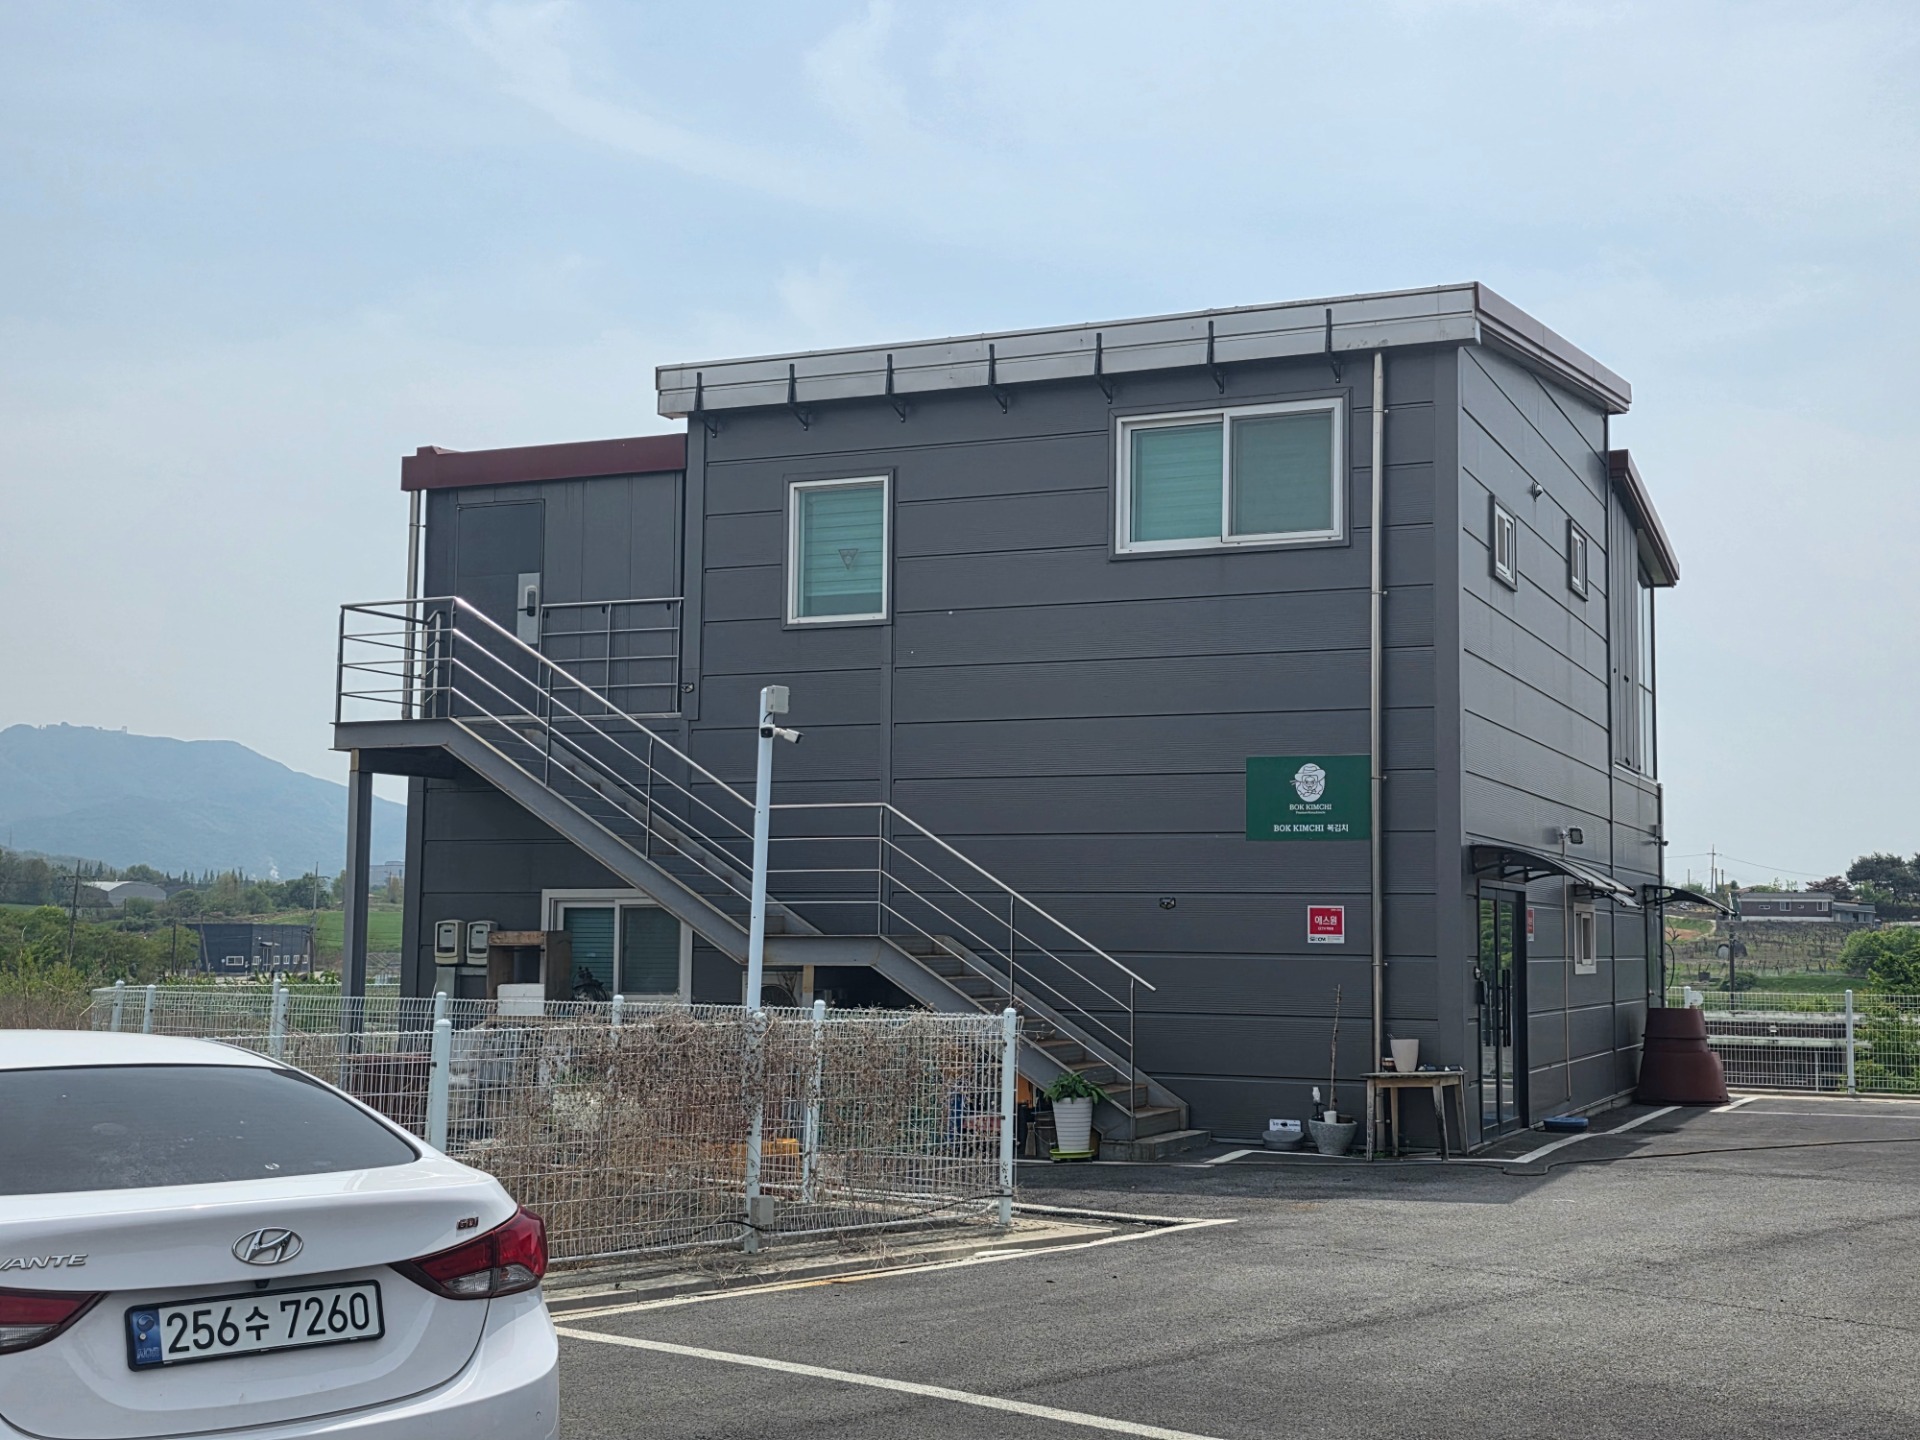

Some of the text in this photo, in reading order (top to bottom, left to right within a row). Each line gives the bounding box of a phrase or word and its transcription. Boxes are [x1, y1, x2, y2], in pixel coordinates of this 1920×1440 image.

[1289, 803, 1332, 811] BOK KIMCHI
[1273, 824, 1292, 832] BOK
[1293, 824, 1324, 832] KIMCHI
[1314, 915, 1337, 925] 에스원
